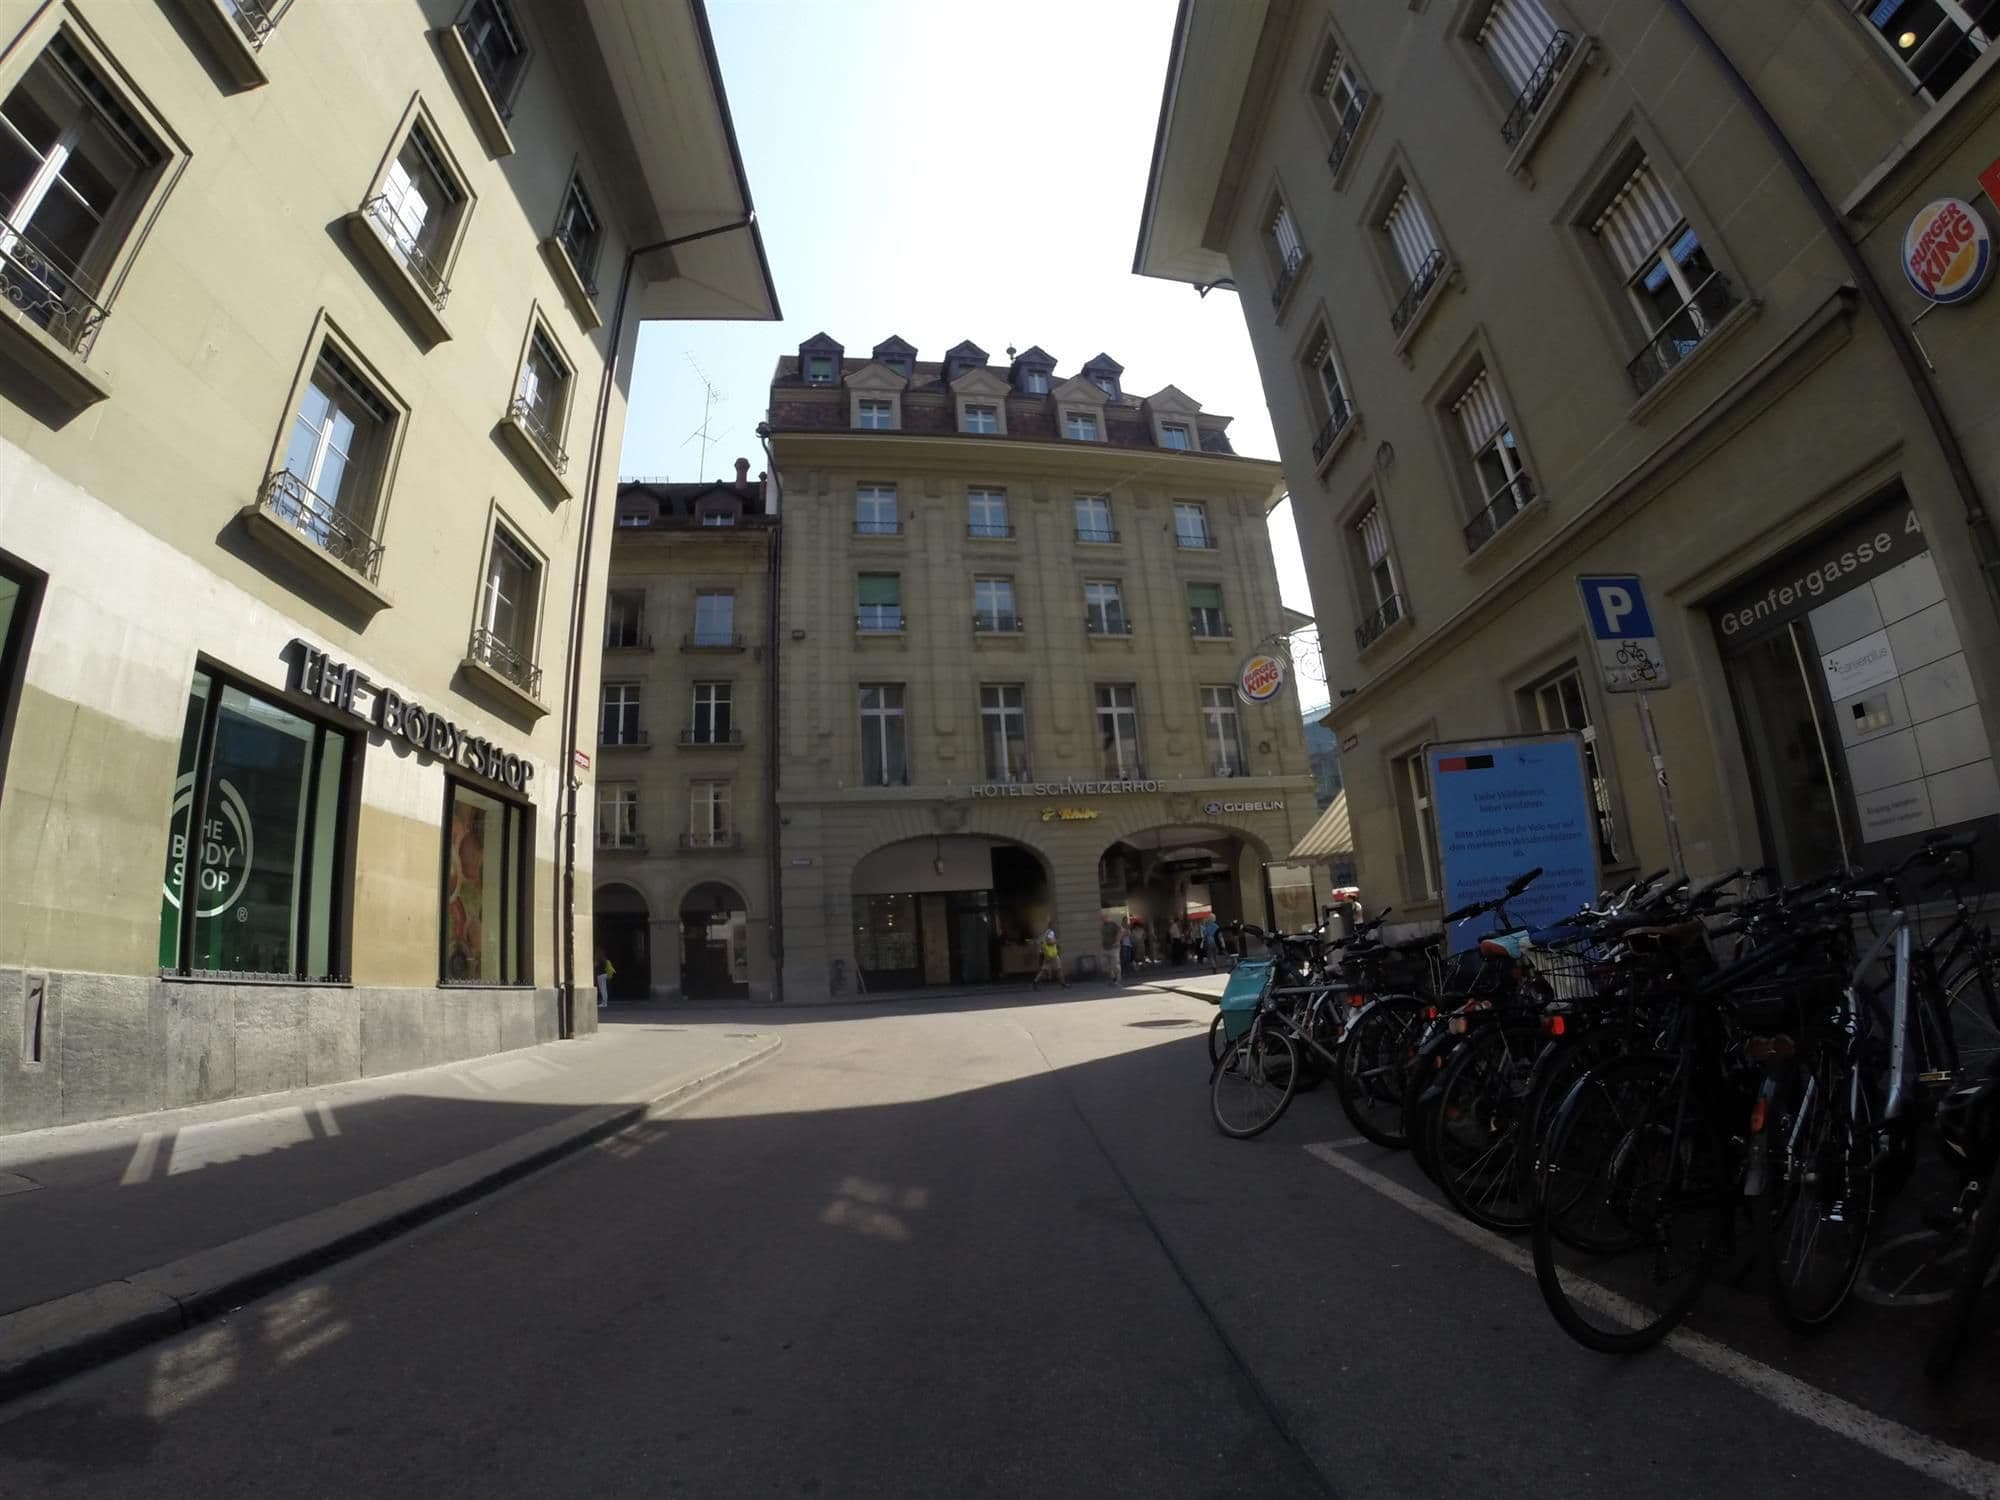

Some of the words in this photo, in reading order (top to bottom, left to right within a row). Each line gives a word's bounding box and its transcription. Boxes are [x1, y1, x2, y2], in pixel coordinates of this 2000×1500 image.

[1910, 202, 1960, 276] BURGER
[1921, 213, 1975, 296] KING
[1720, 531, 1893, 636] Genfergasse
[1904, 509, 1922, 535] 4
[1597, 586, 1633, 633] P
[1247, 667, 1279, 695] KING
[292, 637, 377, 725] THE
[382, 687, 469, 767] BODY
[473, 736, 535, 794] SHOP
[970, 783, 1028, 797] HOTEL
[1034, 779, 1165, 797] SCHWEIZERHOF
[175, 862, 230, 891] SOP
